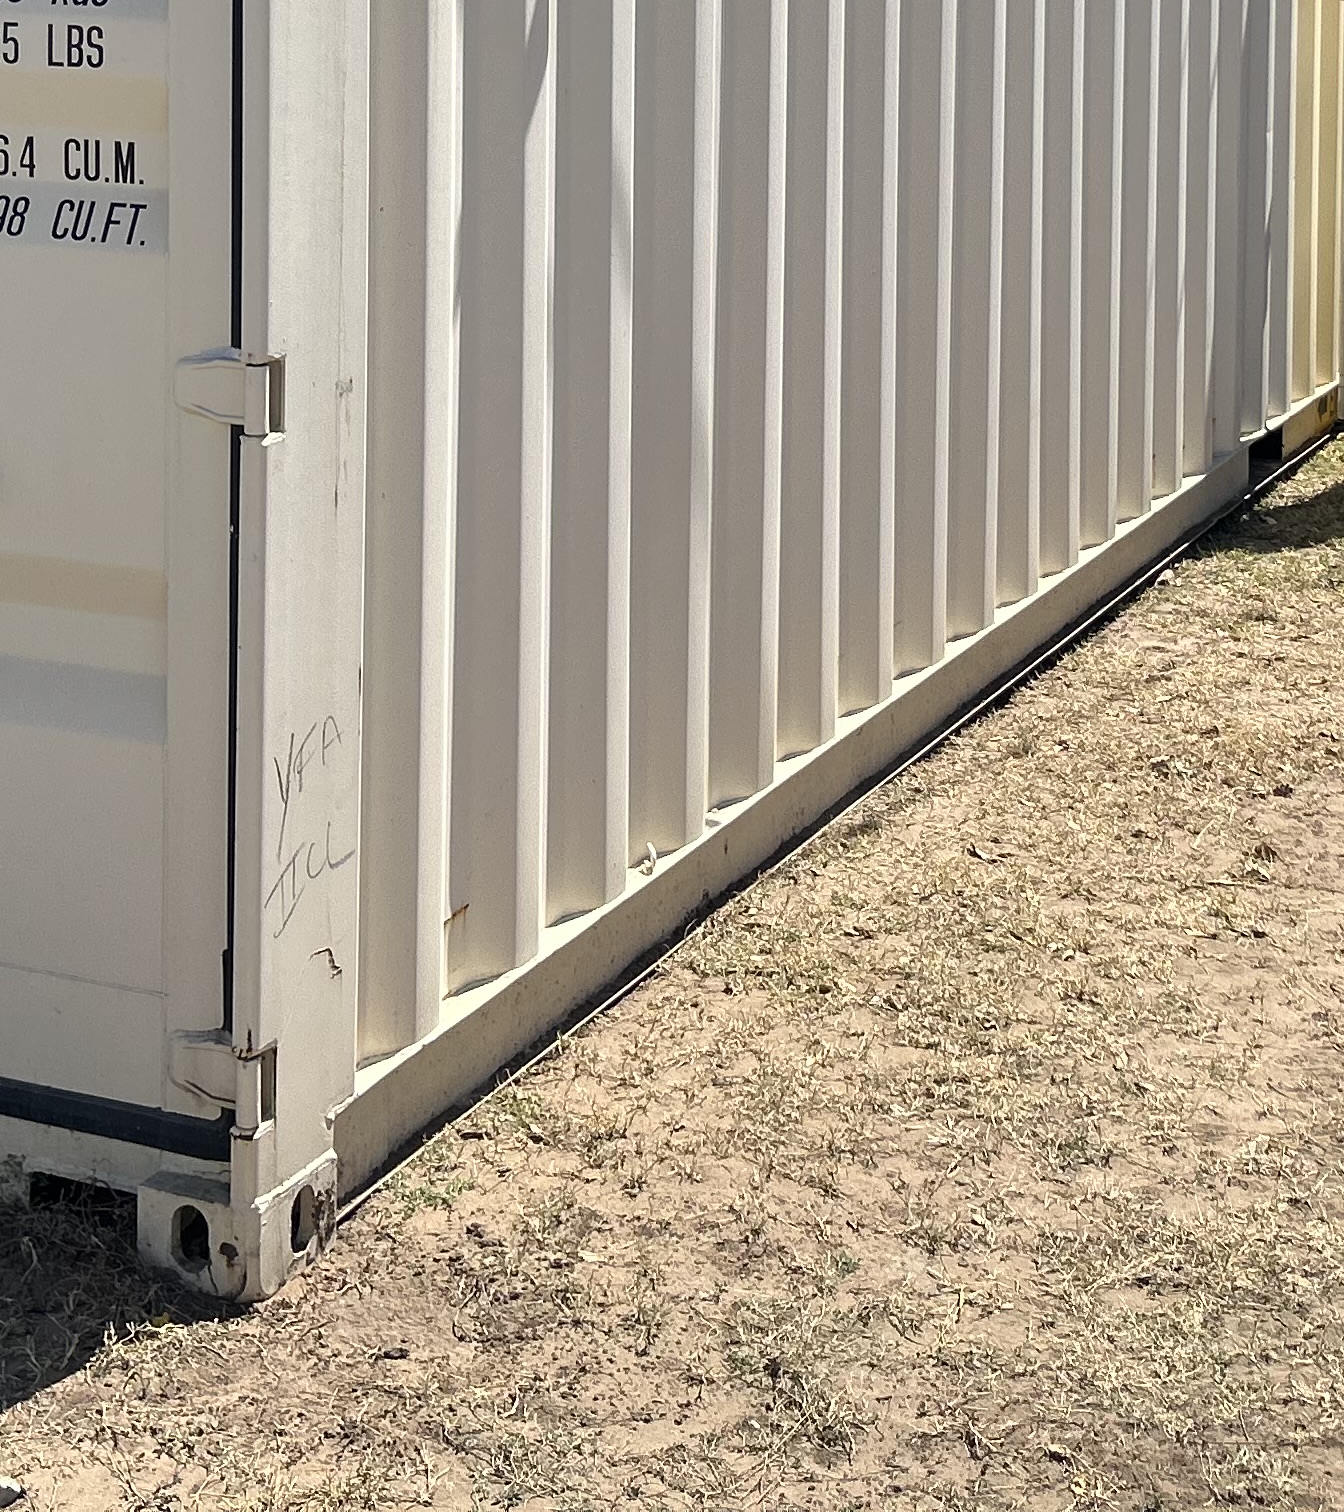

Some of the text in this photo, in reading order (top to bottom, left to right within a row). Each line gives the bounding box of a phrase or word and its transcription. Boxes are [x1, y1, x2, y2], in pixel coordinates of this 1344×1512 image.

[47, 23, 104, 69] LBS
[64, 138, 145, 185] CU.M.
[51, 199, 148, 246] CU.FT.
